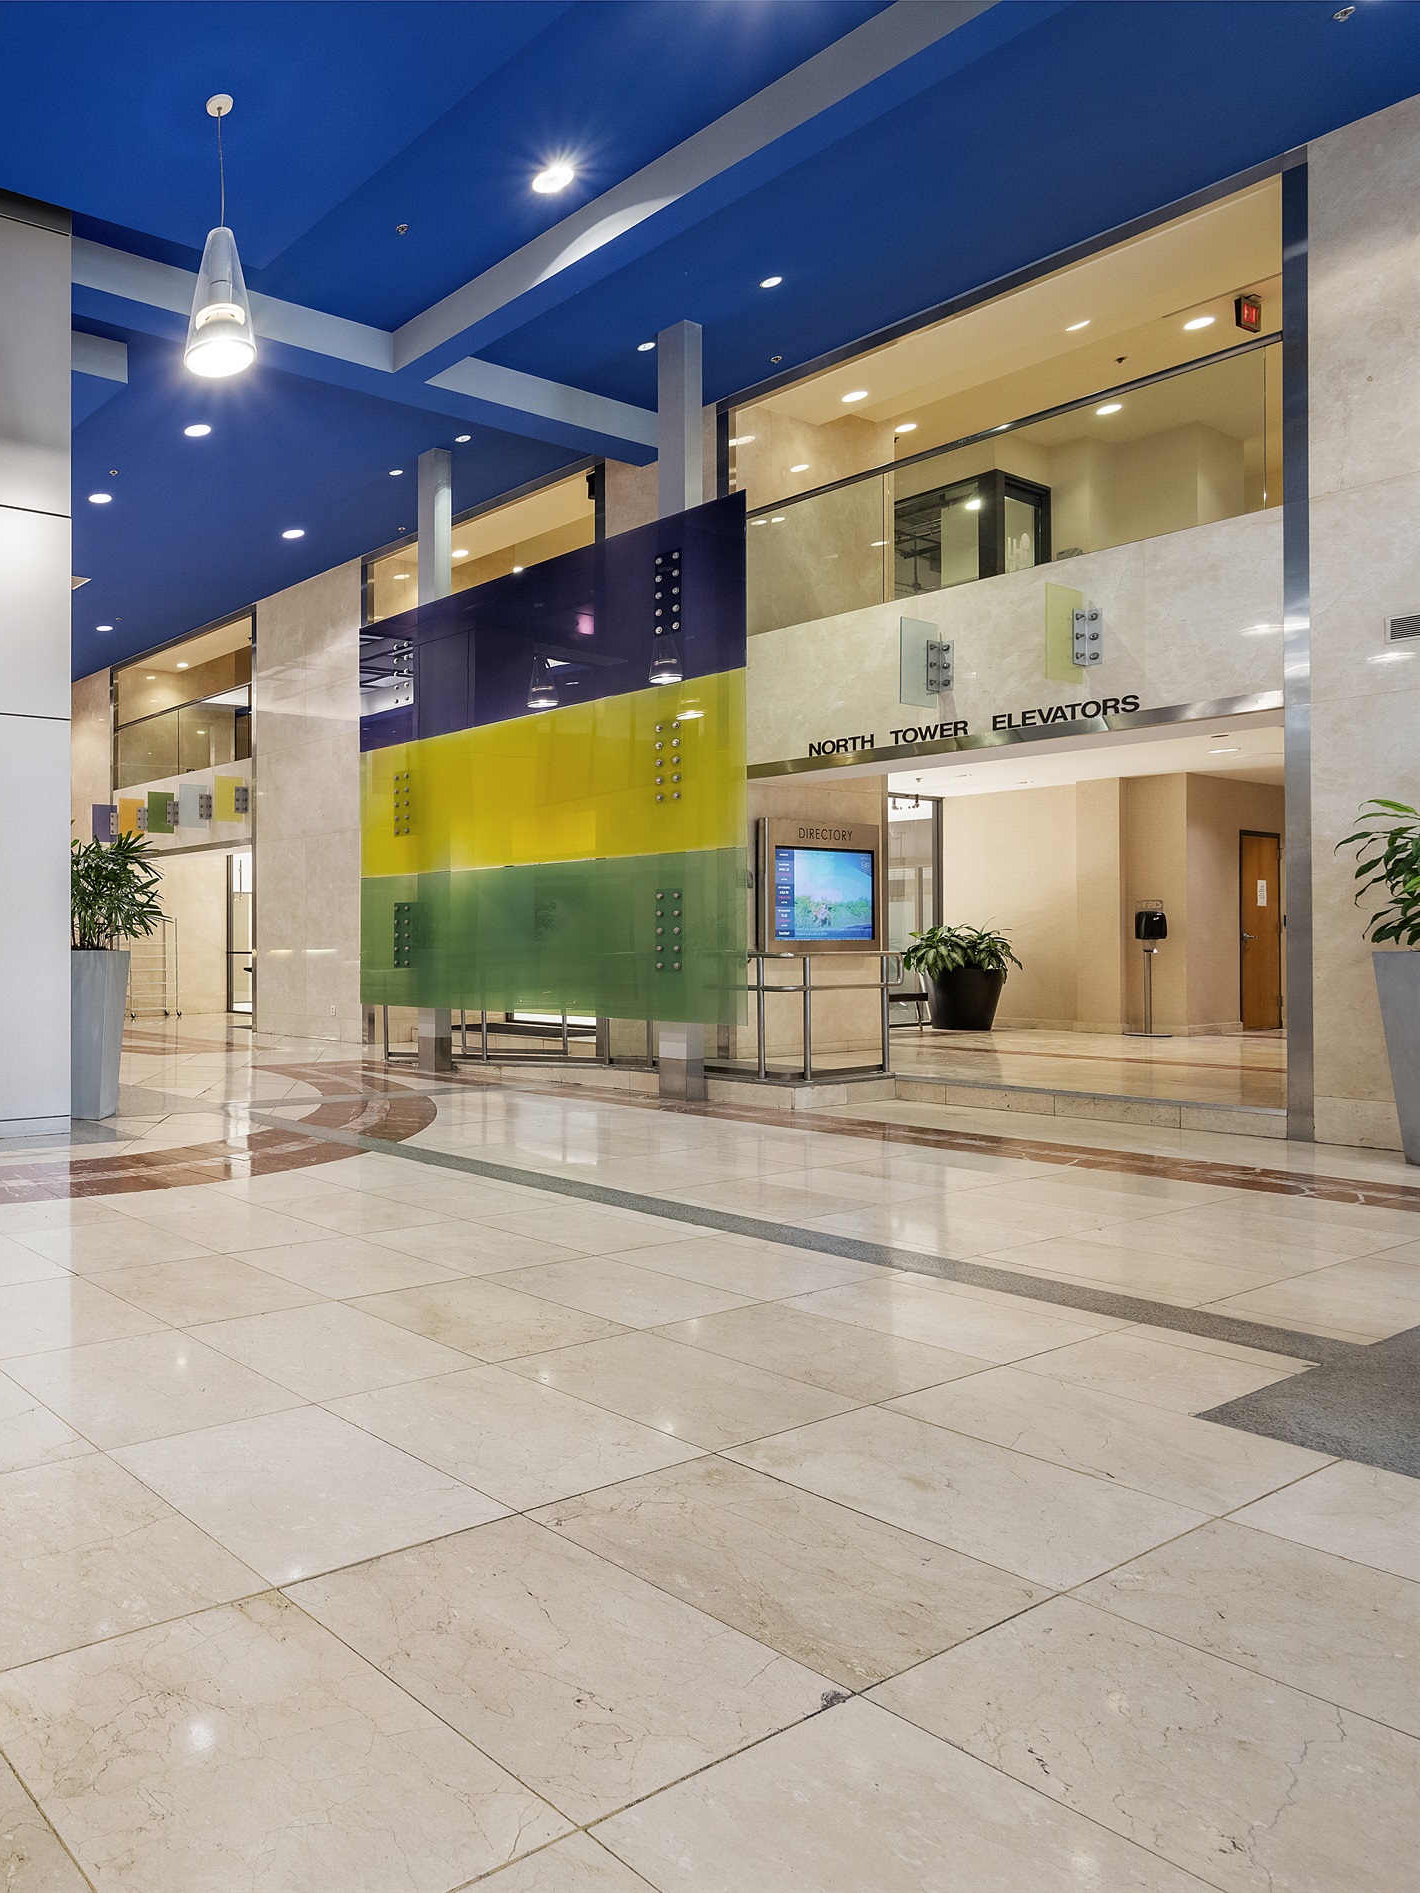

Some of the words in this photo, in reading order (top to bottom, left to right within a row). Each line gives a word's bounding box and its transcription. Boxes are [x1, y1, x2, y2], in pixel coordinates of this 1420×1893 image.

[808, 734, 875, 757] NORTH
[890, 720, 969, 745] TOWER
[991, 694, 1141, 731] ELEVATORS
[798, 827, 853, 841] DIRECTORY
